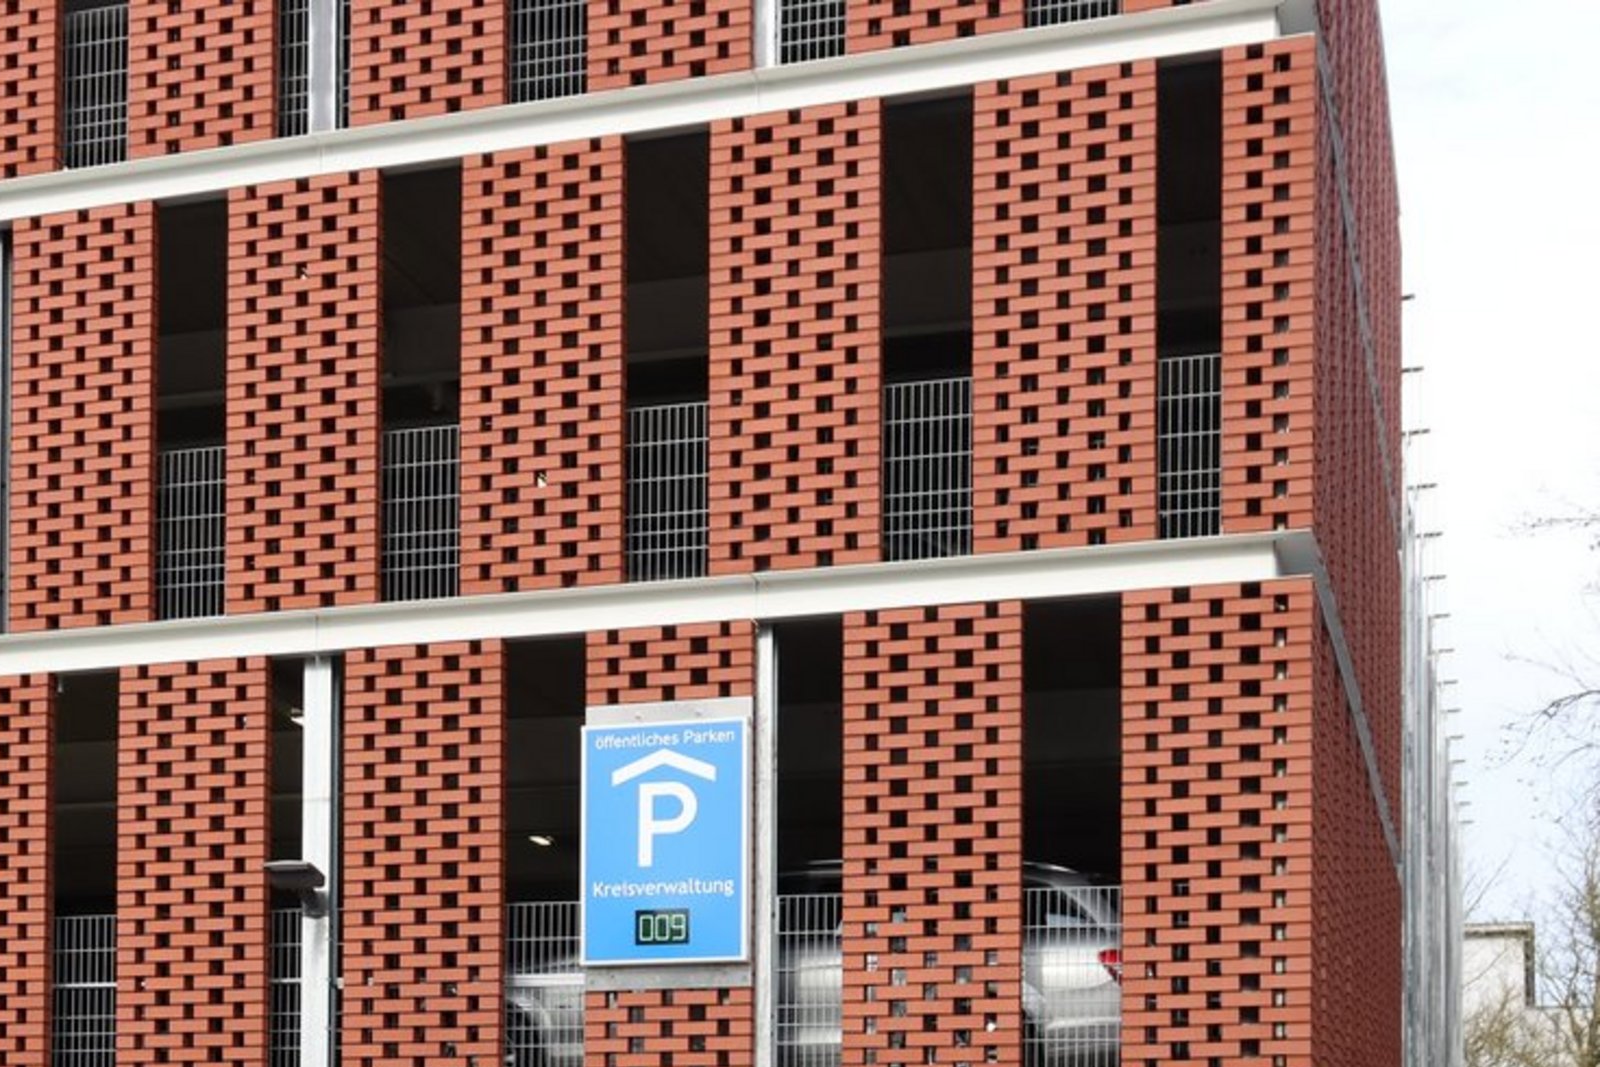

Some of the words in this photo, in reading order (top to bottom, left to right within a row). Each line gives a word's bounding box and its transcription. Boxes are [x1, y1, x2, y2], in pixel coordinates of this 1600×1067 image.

[595, 731, 679, 750] öffentliches
[683, 727, 735, 745] Parken
[593, 878, 735, 897] Kreisverwaltung
[639, 914, 687, 941] 009
